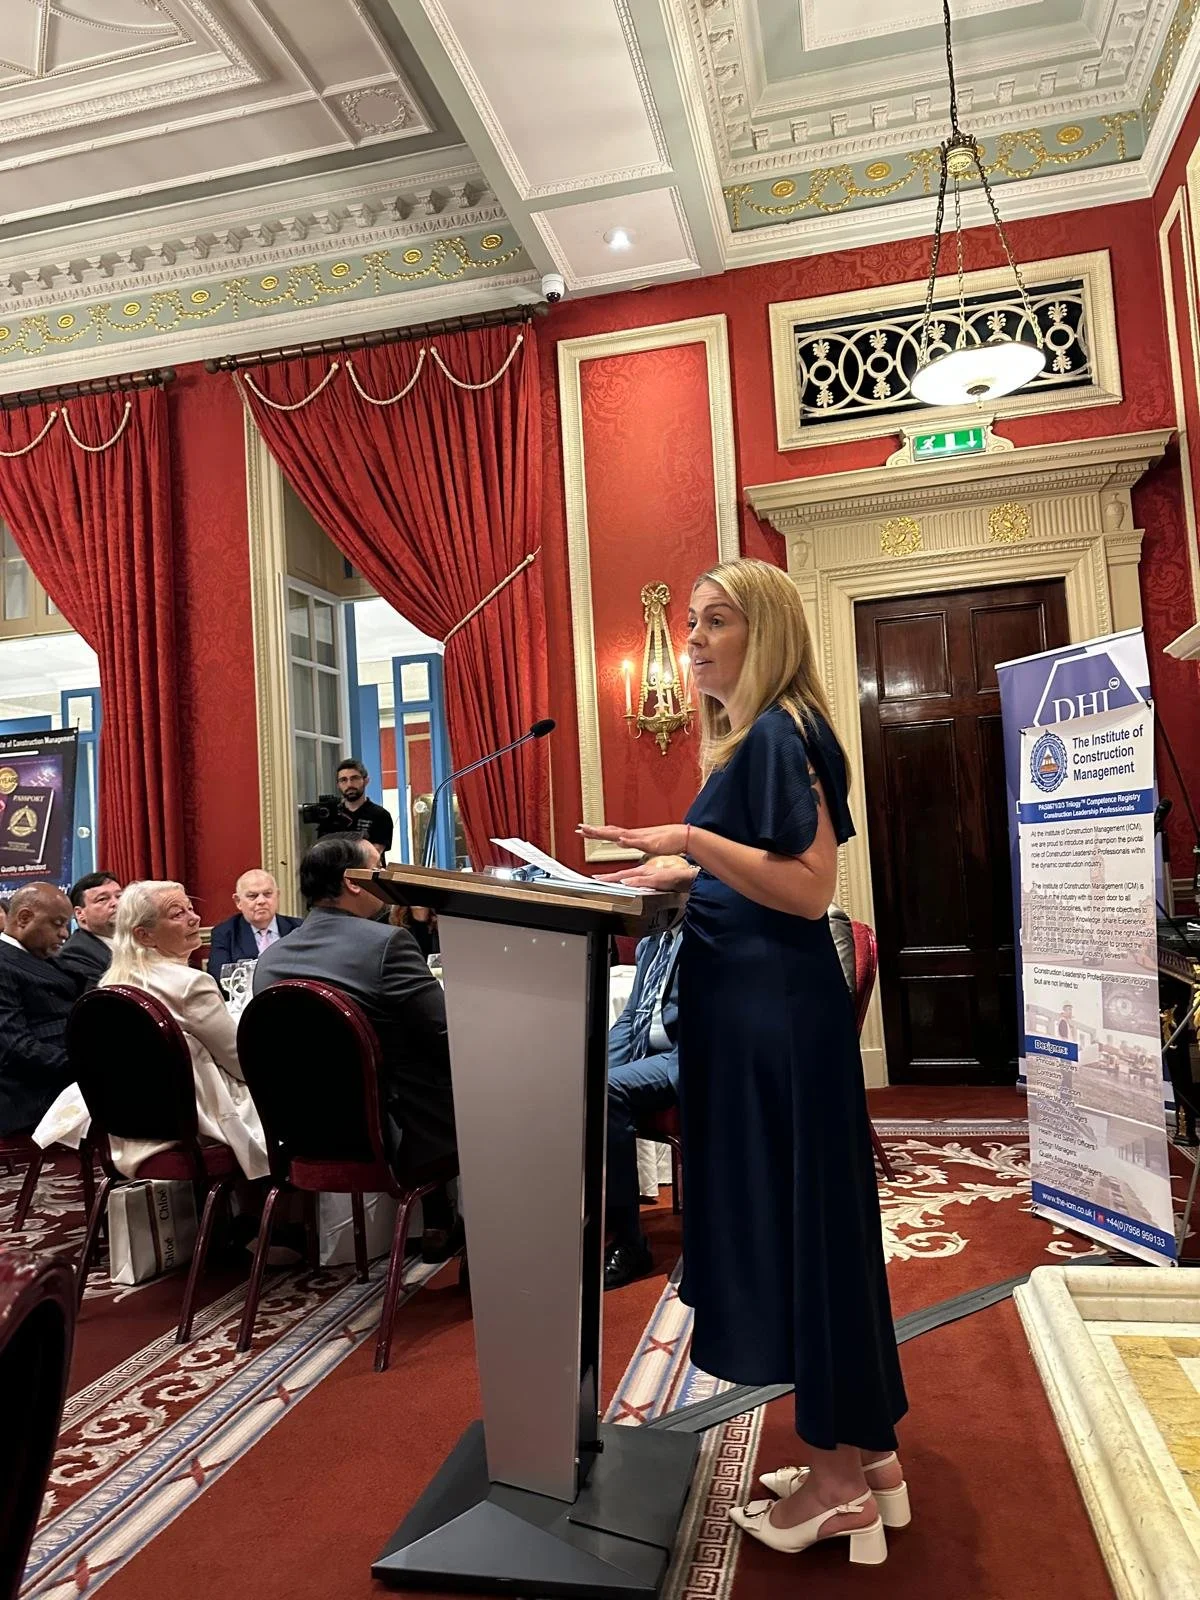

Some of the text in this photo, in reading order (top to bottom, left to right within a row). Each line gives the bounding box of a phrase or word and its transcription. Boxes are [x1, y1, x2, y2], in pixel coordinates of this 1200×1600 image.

[1052, 689, 1110, 723] DHI
[13, 738, 44, 747] Construction
[44, 735, 76, 744] Management
[1073, 724, 1144, 750] The Institute of
[1073, 746, 1134, 765] Construction
[1073, 762, 1135, 781] Management
[1086, 796, 1117, 806] Competence
[1117, 793, 1141, 803] Registry
[1043, 803, 1136, 820] Construction Leadership Professionals
[1066, 827, 1093, 836] Construction
[1094, 824, 1125, 834] Management
[1046, 850, 1071, 858] Construction
[1097, 847, 1130, 856] Professionals
[1064, 882, 1091, 890] Construction
[1091, 881, 1124, 891] Management
[1033, 967, 1062, 976] Construction
[1063, 970, 1086, 981] Leadership
[1087, 972, 1120, 984] Professionals
[1035, 1040, 1068, 1055] Designers:
